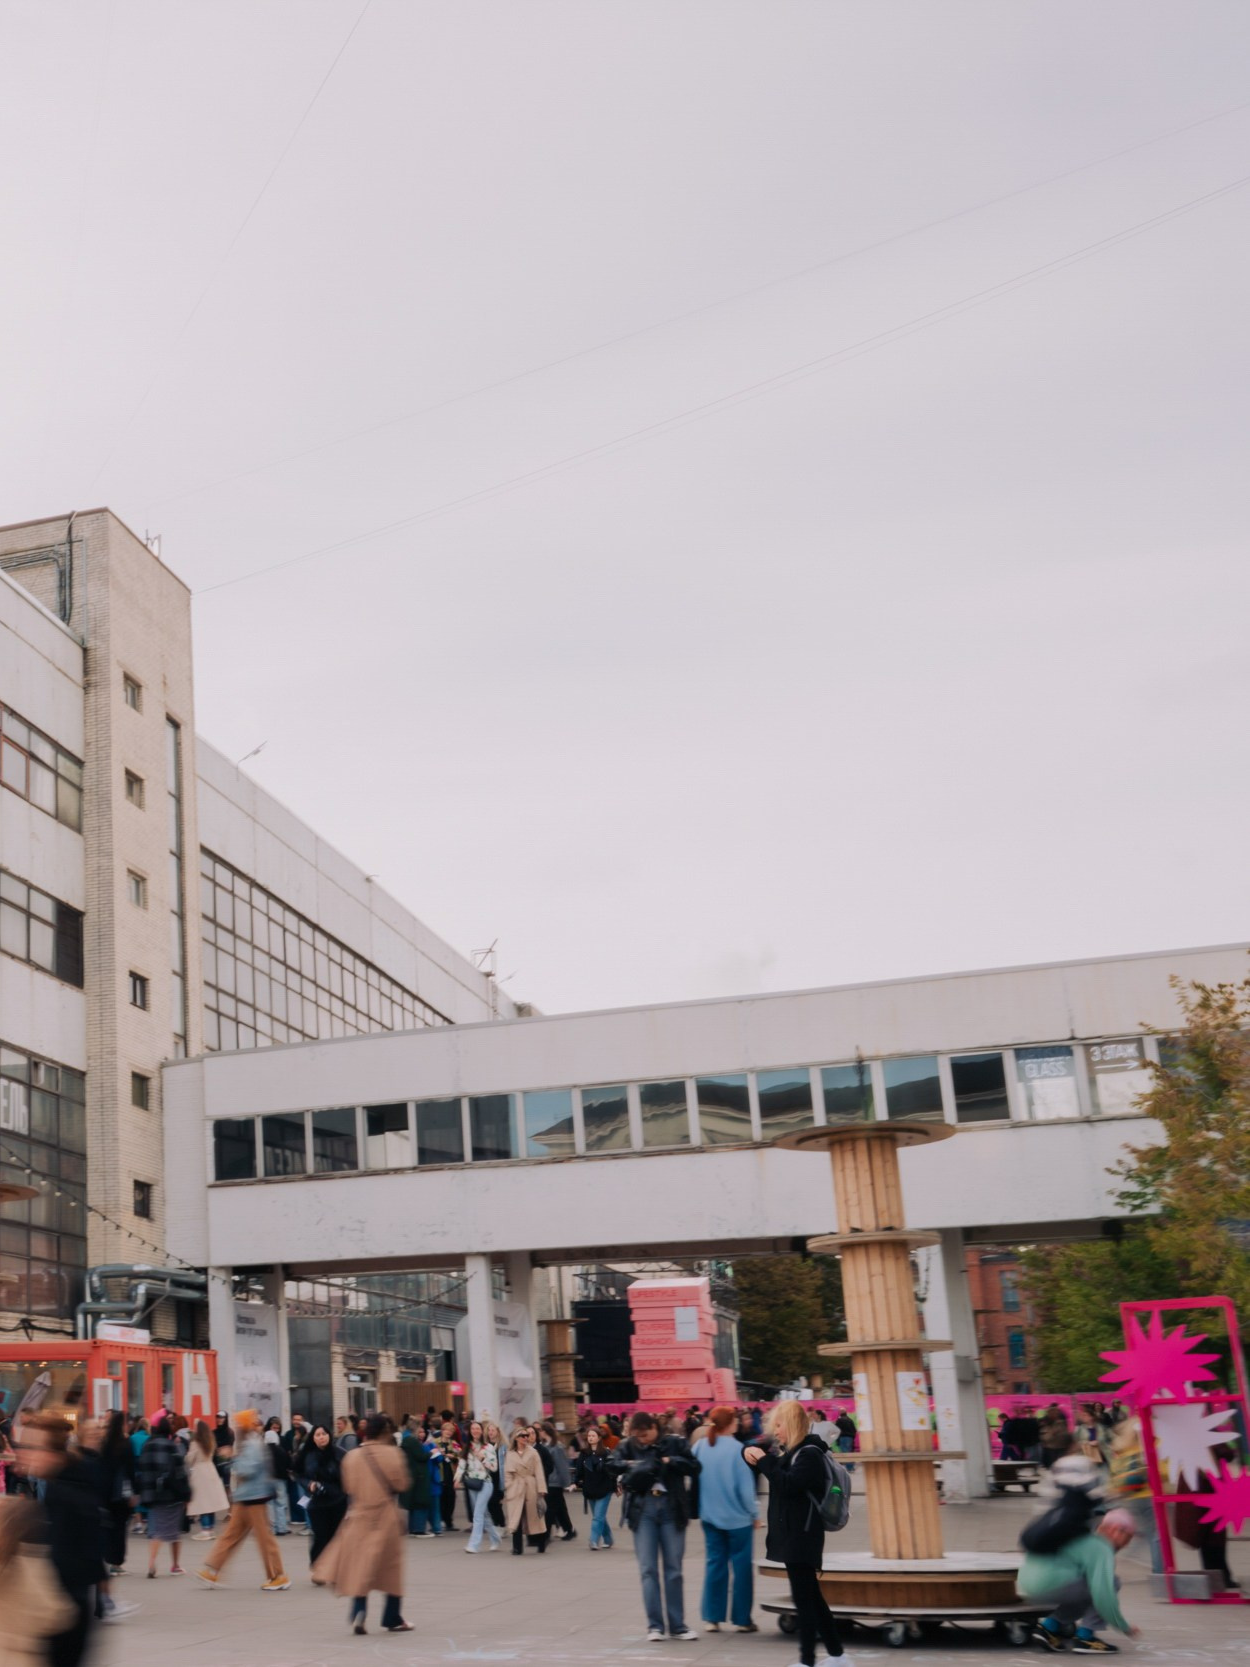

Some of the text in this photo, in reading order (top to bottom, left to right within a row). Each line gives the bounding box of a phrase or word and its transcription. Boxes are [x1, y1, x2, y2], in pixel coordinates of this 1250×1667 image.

[1090, 1046, 1101, 1061] 3
[1102, 1043, 1139, 1060] ЭТАЖ
[631, 1289, 678, 1299] LIFESTYLE
[635, 1337, 675, 1346] FASHION
[637, 1373, 676, 1381] FASHION
[643, 1387, 689, 1396] LIFESTYLE
